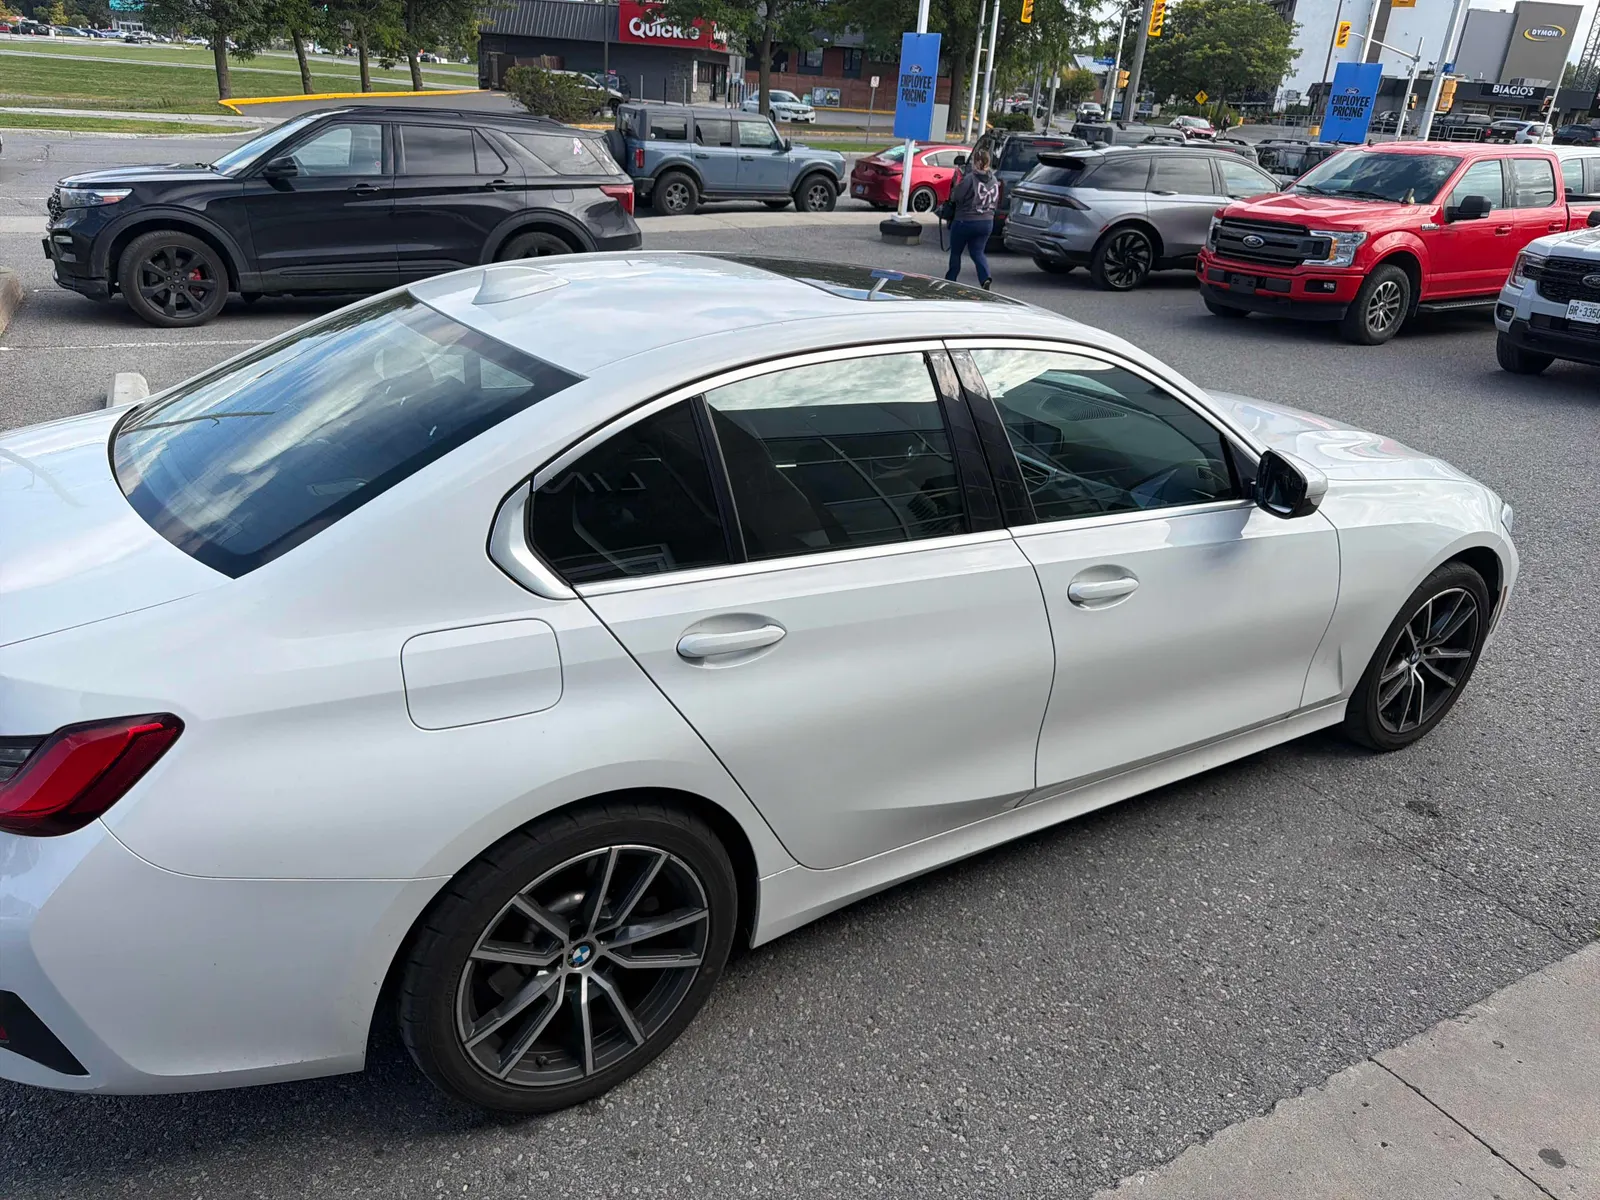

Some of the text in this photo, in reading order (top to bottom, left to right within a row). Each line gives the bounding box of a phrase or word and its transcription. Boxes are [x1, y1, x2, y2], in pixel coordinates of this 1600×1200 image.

[1531, 28, 1559, 37] DYMON
[900, 74, 932, 90] EMPLOYEE
[901, 88, 927, 104] PRICING
[1492, 84, 1535, 96] BIAGIO'S
[1331, 94, 1371, 108] EMPLOYEE
[1332, 105, 1364, 118] PRICING
